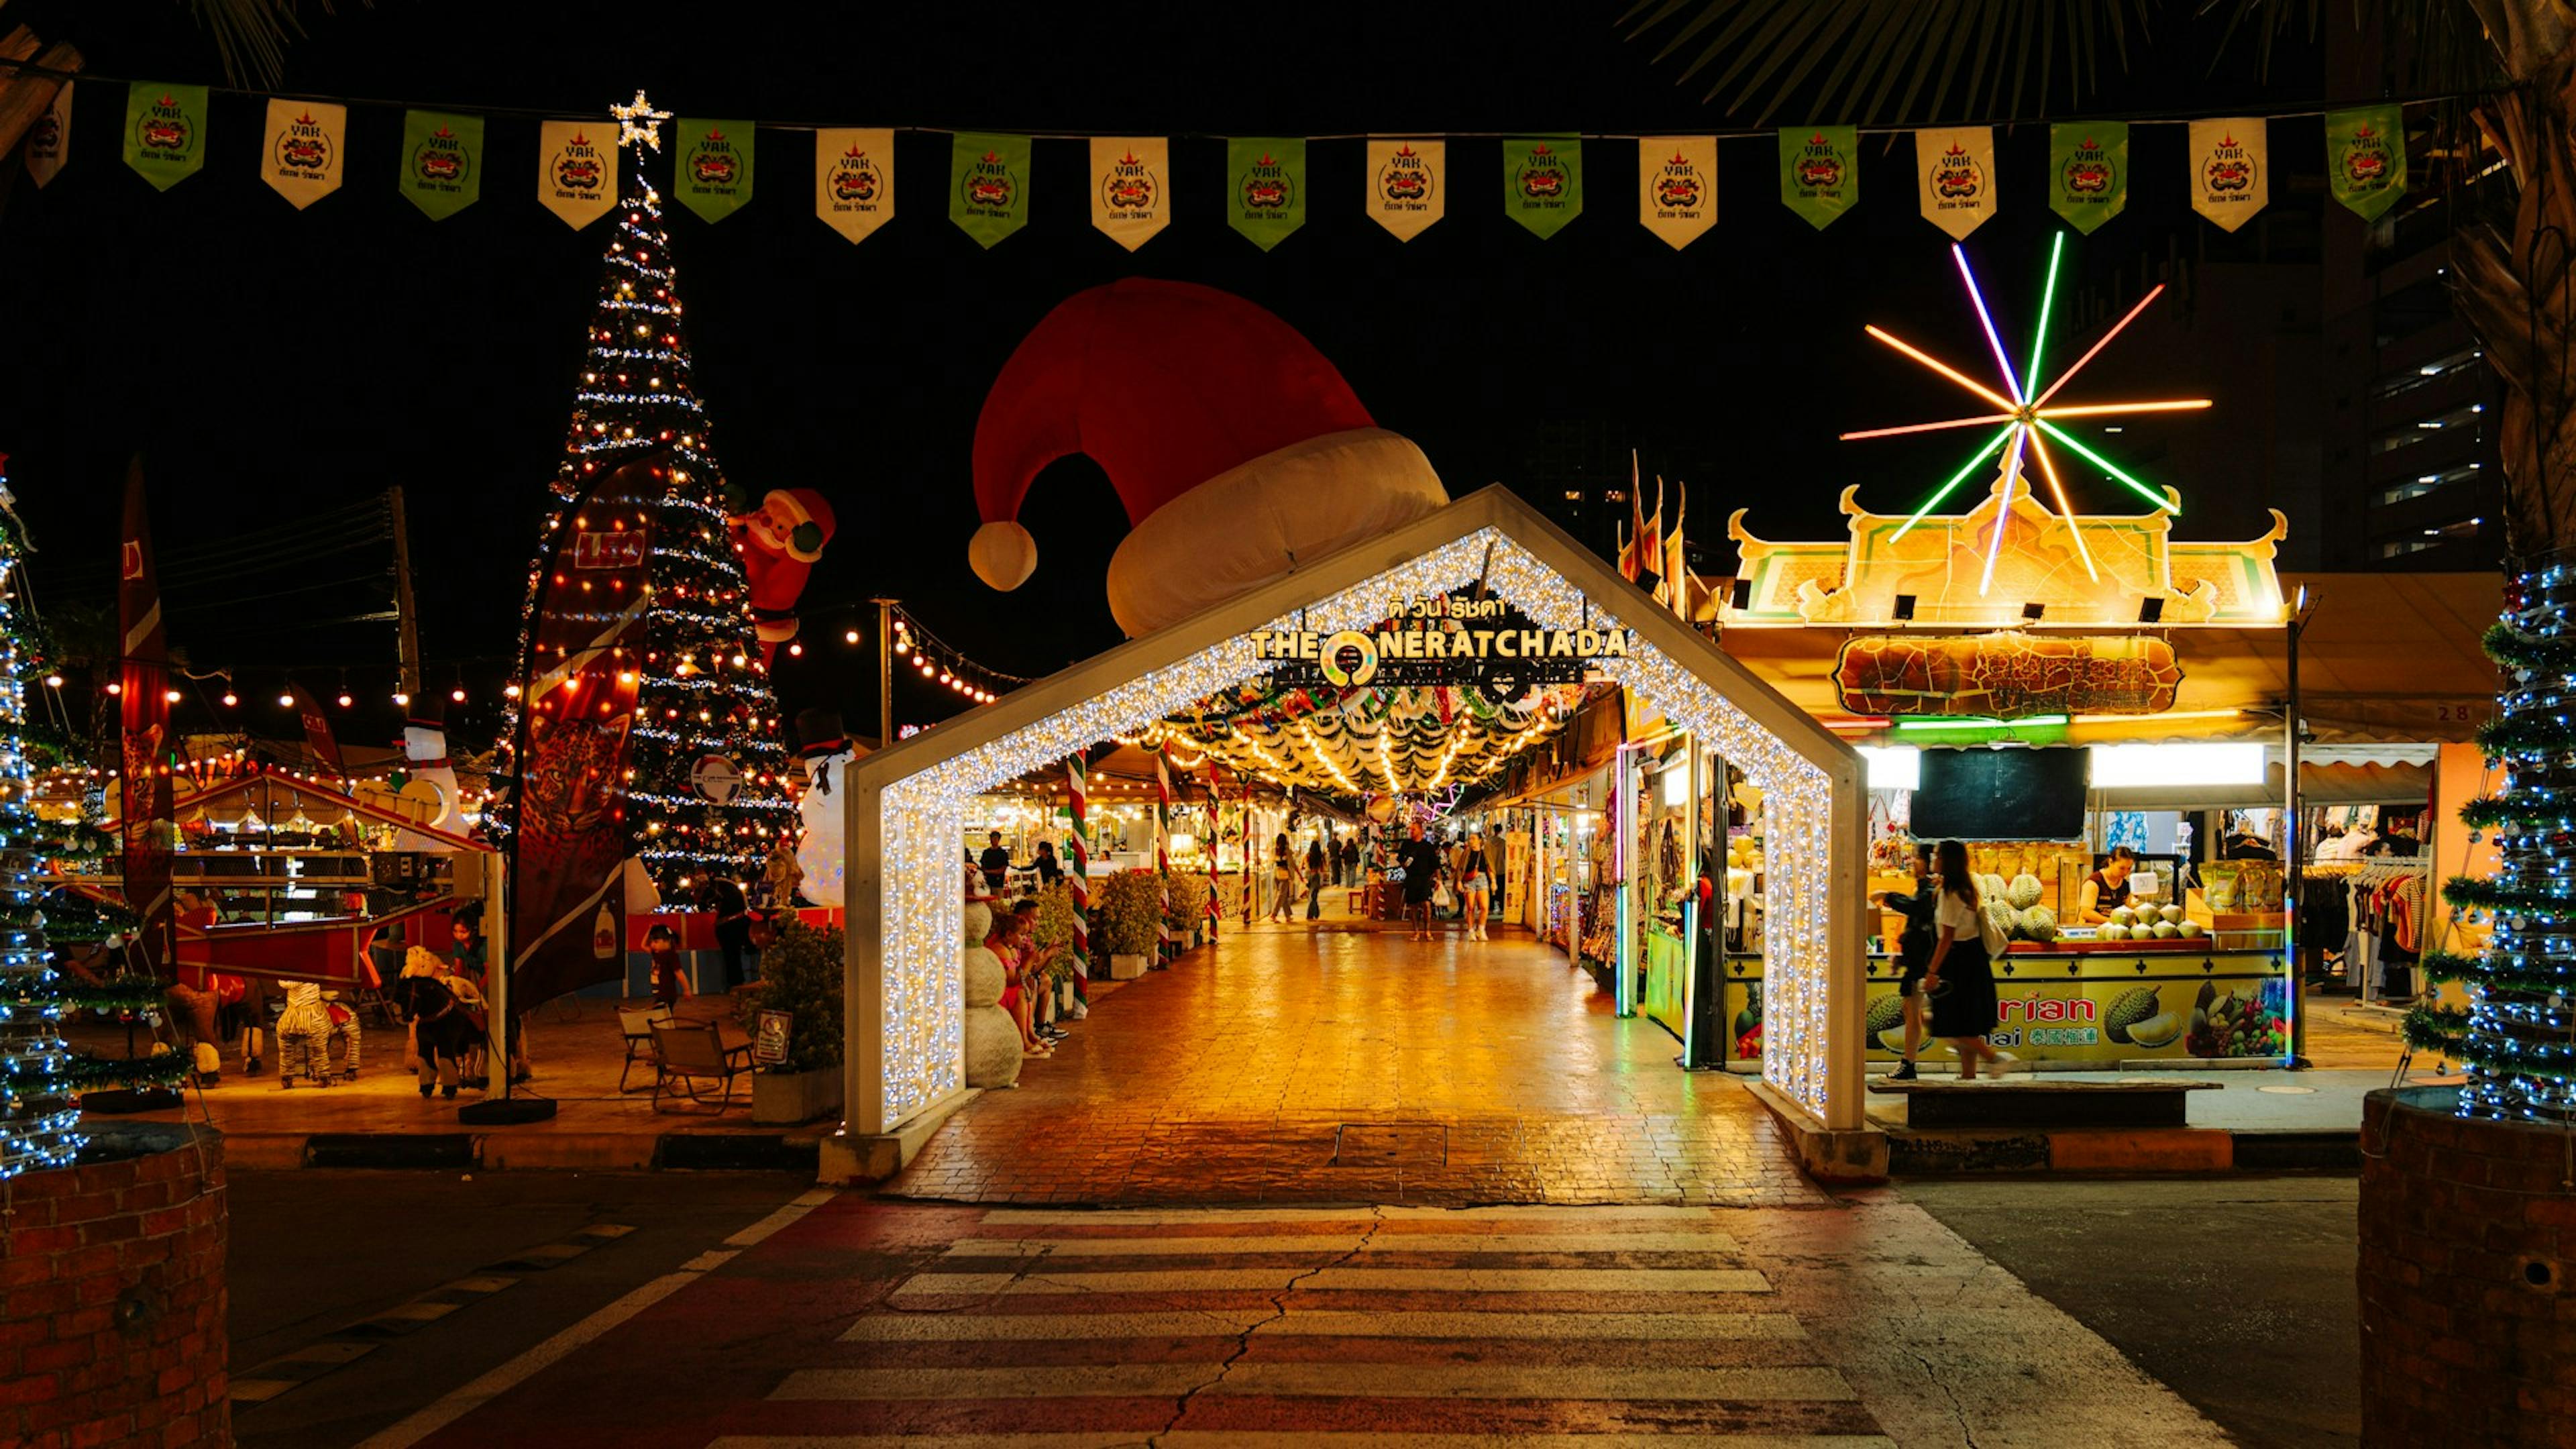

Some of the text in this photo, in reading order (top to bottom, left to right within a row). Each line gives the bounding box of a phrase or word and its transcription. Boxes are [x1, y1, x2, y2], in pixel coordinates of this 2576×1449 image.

[153, 107, 180, 118] YAK
[291, 125, 319, 137] YAK
[429, 138, 458, 150] YAK
[702, 142, 730, 152] YAK
[2352, 138, 2380, 148] YAK
[566, 147, 594, 157] YAK
[1805, 146, 1833, 156] YAK
[2076, 151, 2104, 161] YAK
[2214, 148, 2243, 159] YAK
[841, 159, 869, 168] YAK
[1392, 158, 1420, 168] YAK
[1528, 156, 1557, 166] YAK
[1942, 156, 1970, 166] YAK
[977, 163, 1005, 175] YAK
[1115, 166, 1143, 176] YAK
[1252, 167, 1281, 178] YAK
[1665, 166, 1693, 175] YAK
[1411, 595, 1442, 619] วัน
[1450, 596, 1506, 619] รัชดา
[1250, 631, 1319, 659] THE
[1997, 998, 2096, 1022] rian
